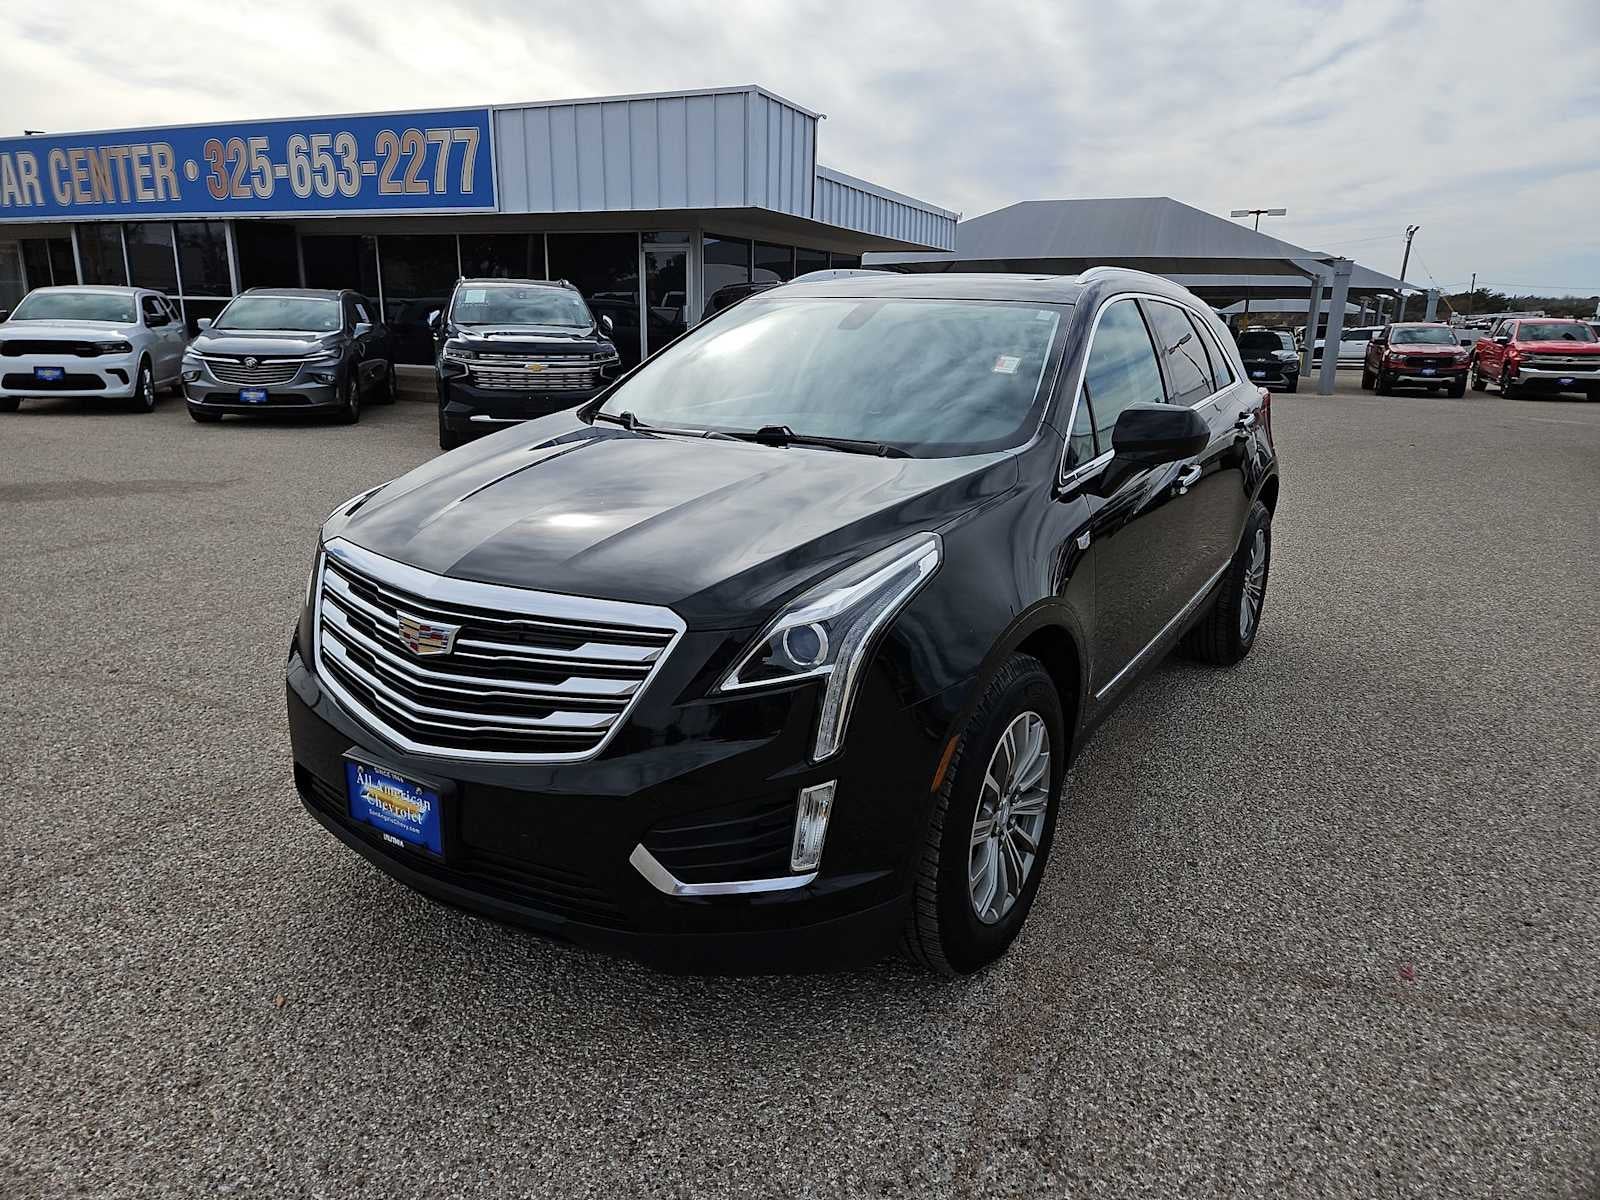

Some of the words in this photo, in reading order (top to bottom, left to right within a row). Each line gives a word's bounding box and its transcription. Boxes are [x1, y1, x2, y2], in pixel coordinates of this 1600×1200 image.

[48, 141, 182, 207] CENTER
[203, 126, 480, 201] 325-653-2277
[366, 793, 423, 825] Chevrolet
